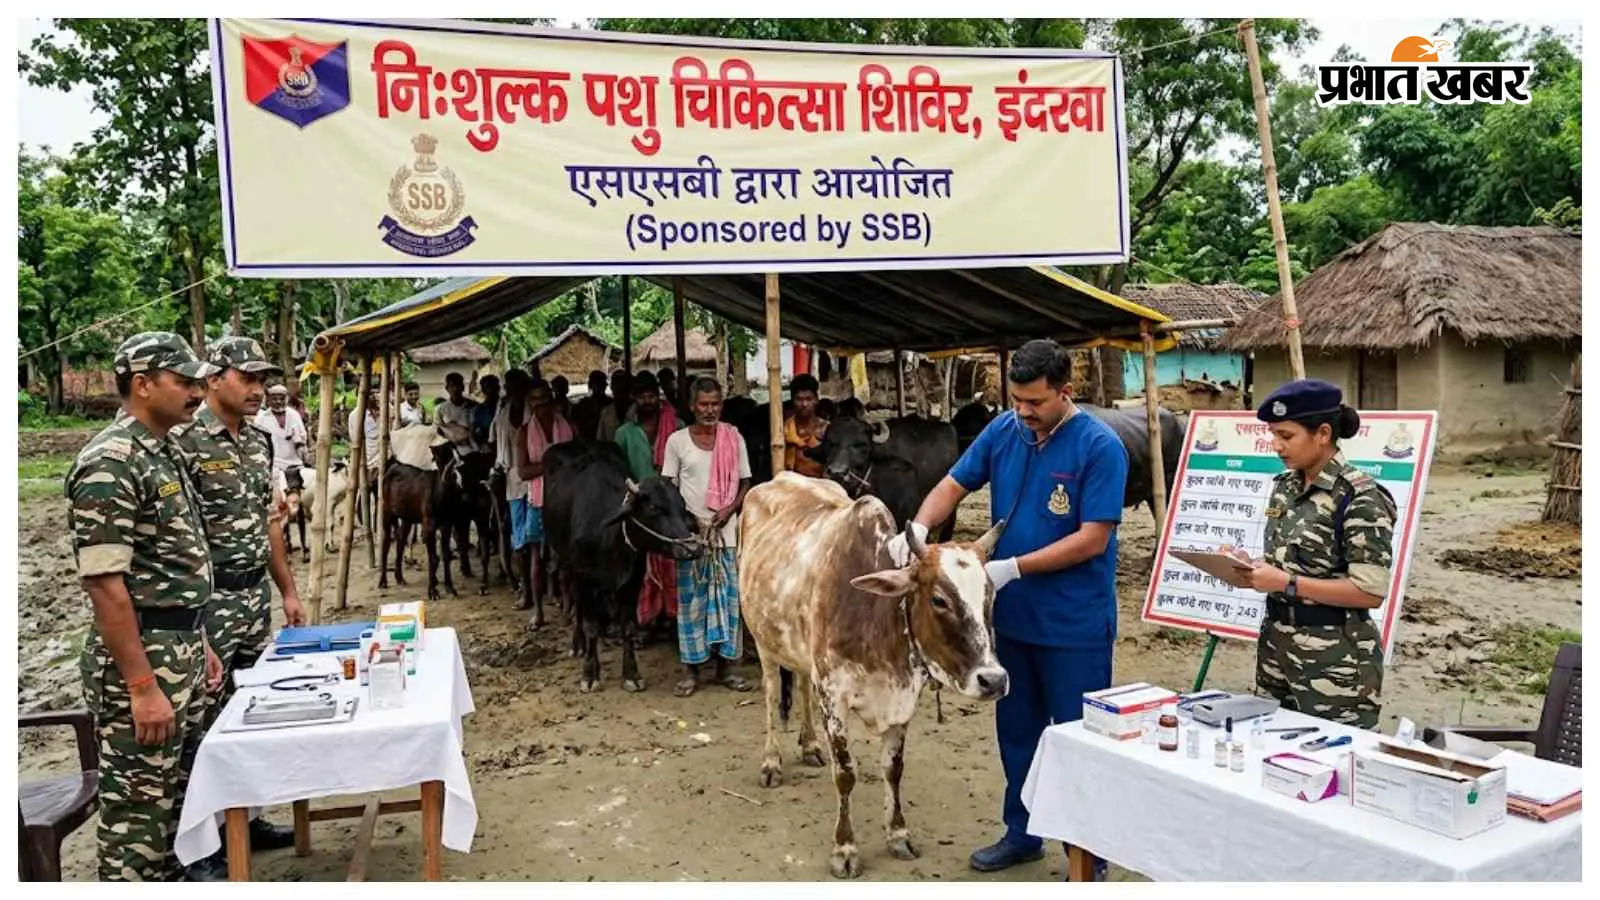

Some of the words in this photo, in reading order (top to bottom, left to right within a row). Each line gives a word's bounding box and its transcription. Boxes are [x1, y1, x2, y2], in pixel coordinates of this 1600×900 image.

[372, 41, 570, 152] निःशुल्क
[583, 73, 660, 156] पशु
[671, 56, 847, 134] चिकित्सा
[858, 64, 983, 141] शिविर,
[995, 69, 1106, 142] इंदरवा
[408, 183, 446, 210] SSB
[565, 155, 723, 208] एसएसबी
[731, 168, 800, 206] द्वारा
[811, 157, 953, 200] आयोजित
[625, 214, 806, 251] (Sponsored
[816, 215, 852, 249] by
[861, 214, 932, 247] SSB)
[1237, 606, 1258, 617] 243
